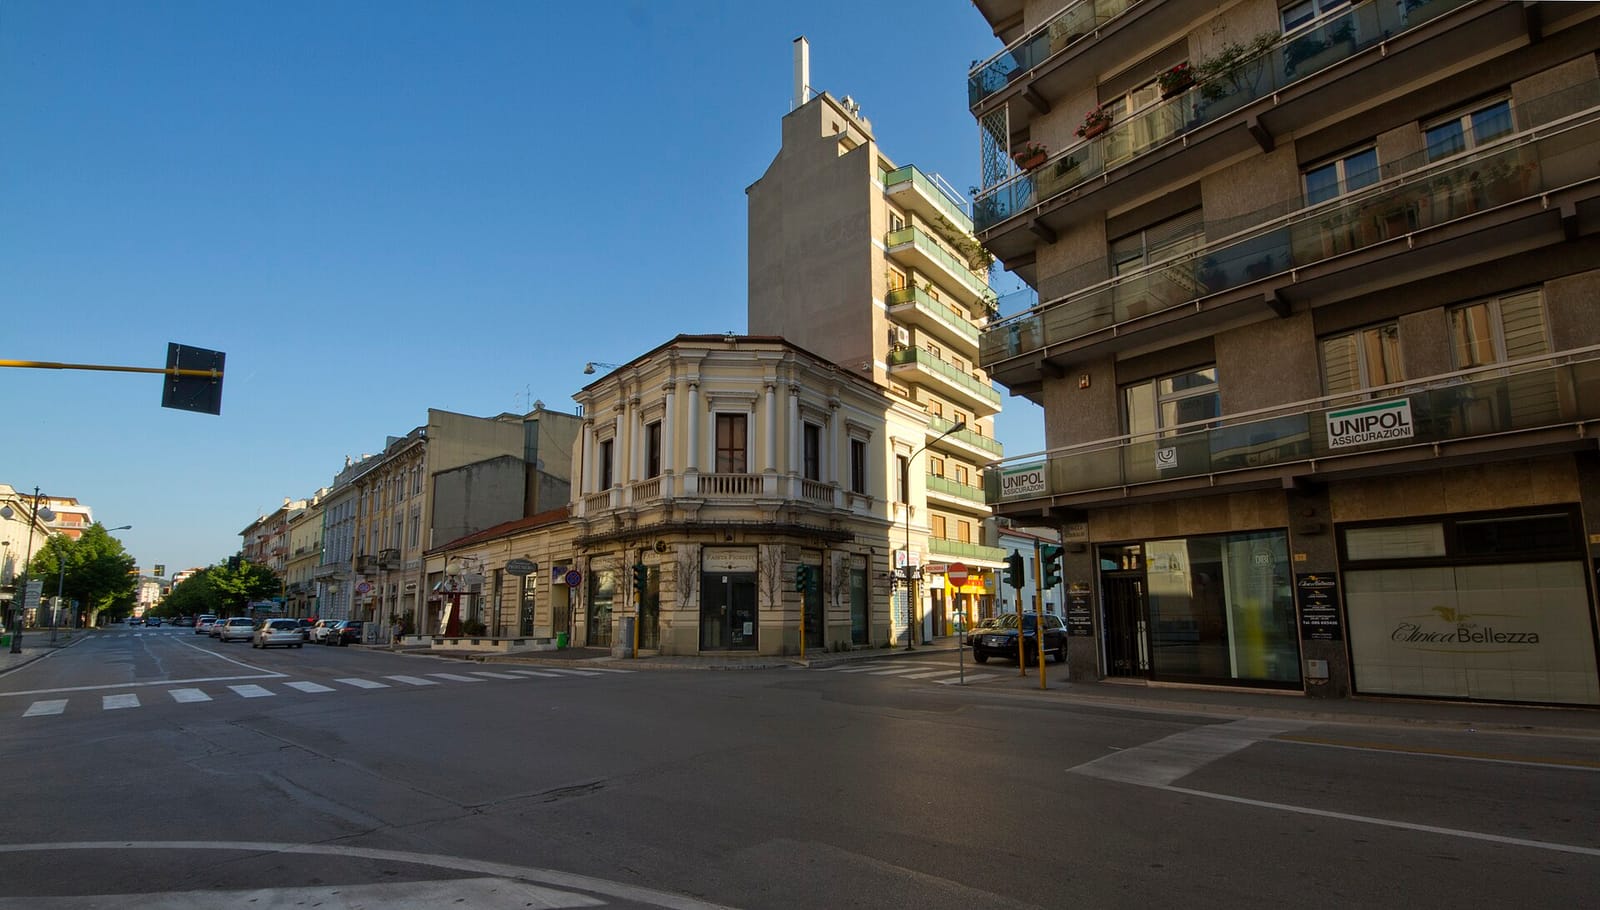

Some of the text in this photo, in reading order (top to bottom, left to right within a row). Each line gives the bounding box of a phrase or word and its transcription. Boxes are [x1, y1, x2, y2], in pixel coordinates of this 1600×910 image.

[1329, 411, 1409, 436] UNIPOL
[1331, 427, 1411, 446] ASSICURAZIONI
[1002, 472, 1044, 489] UNIPOL
[1003, 484, 1044, 496] ASSICURAZIONI
[1391, 623, 1540, 644] Clinica Bellezza
